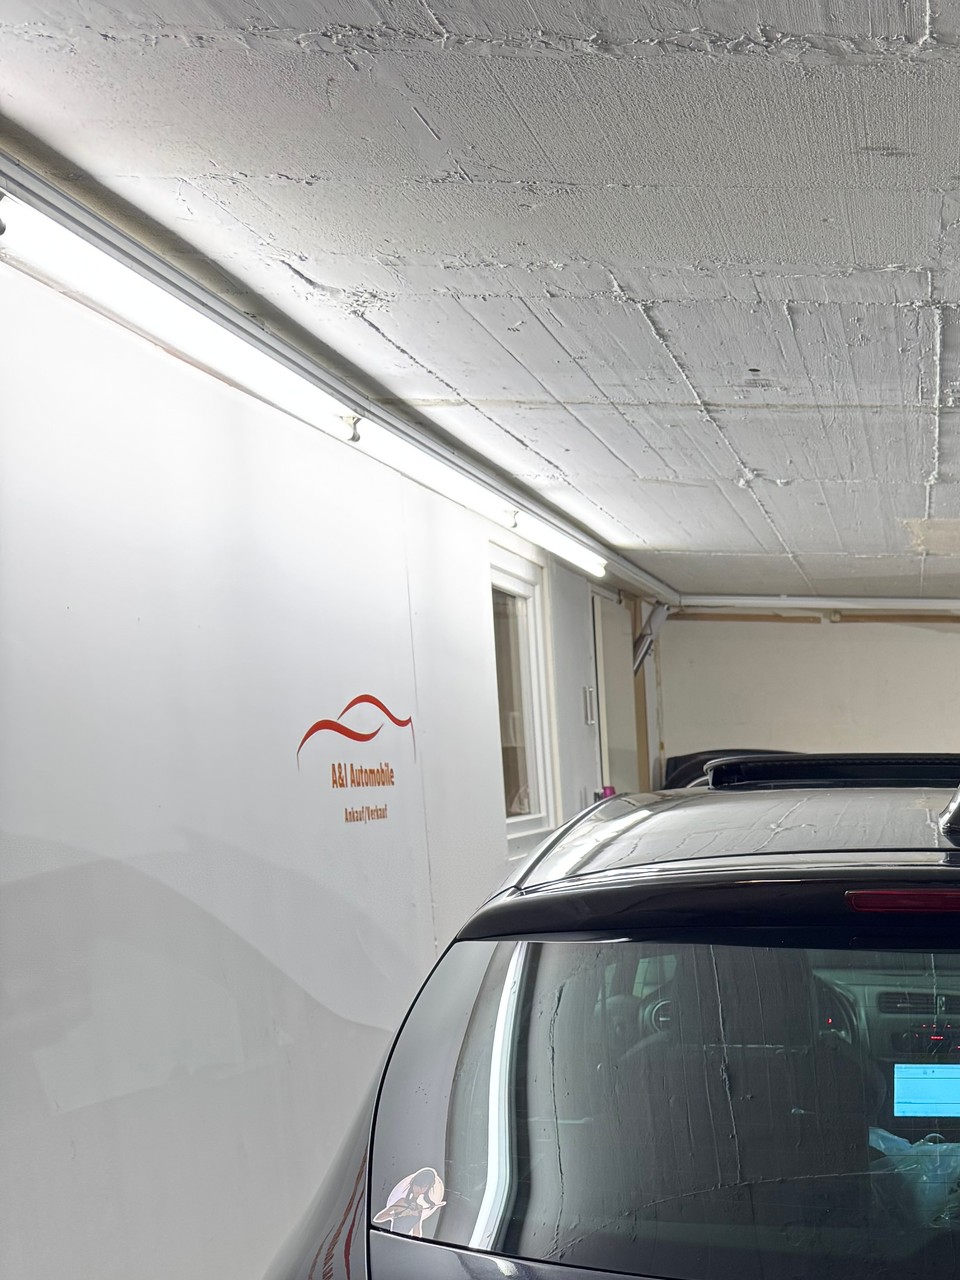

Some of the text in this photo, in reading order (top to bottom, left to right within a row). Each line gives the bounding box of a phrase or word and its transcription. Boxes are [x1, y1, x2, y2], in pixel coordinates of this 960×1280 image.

[331, 762, 394, 788] A&I Automobile
[345, 804, 387, 824] Ankauf/Verkauf
